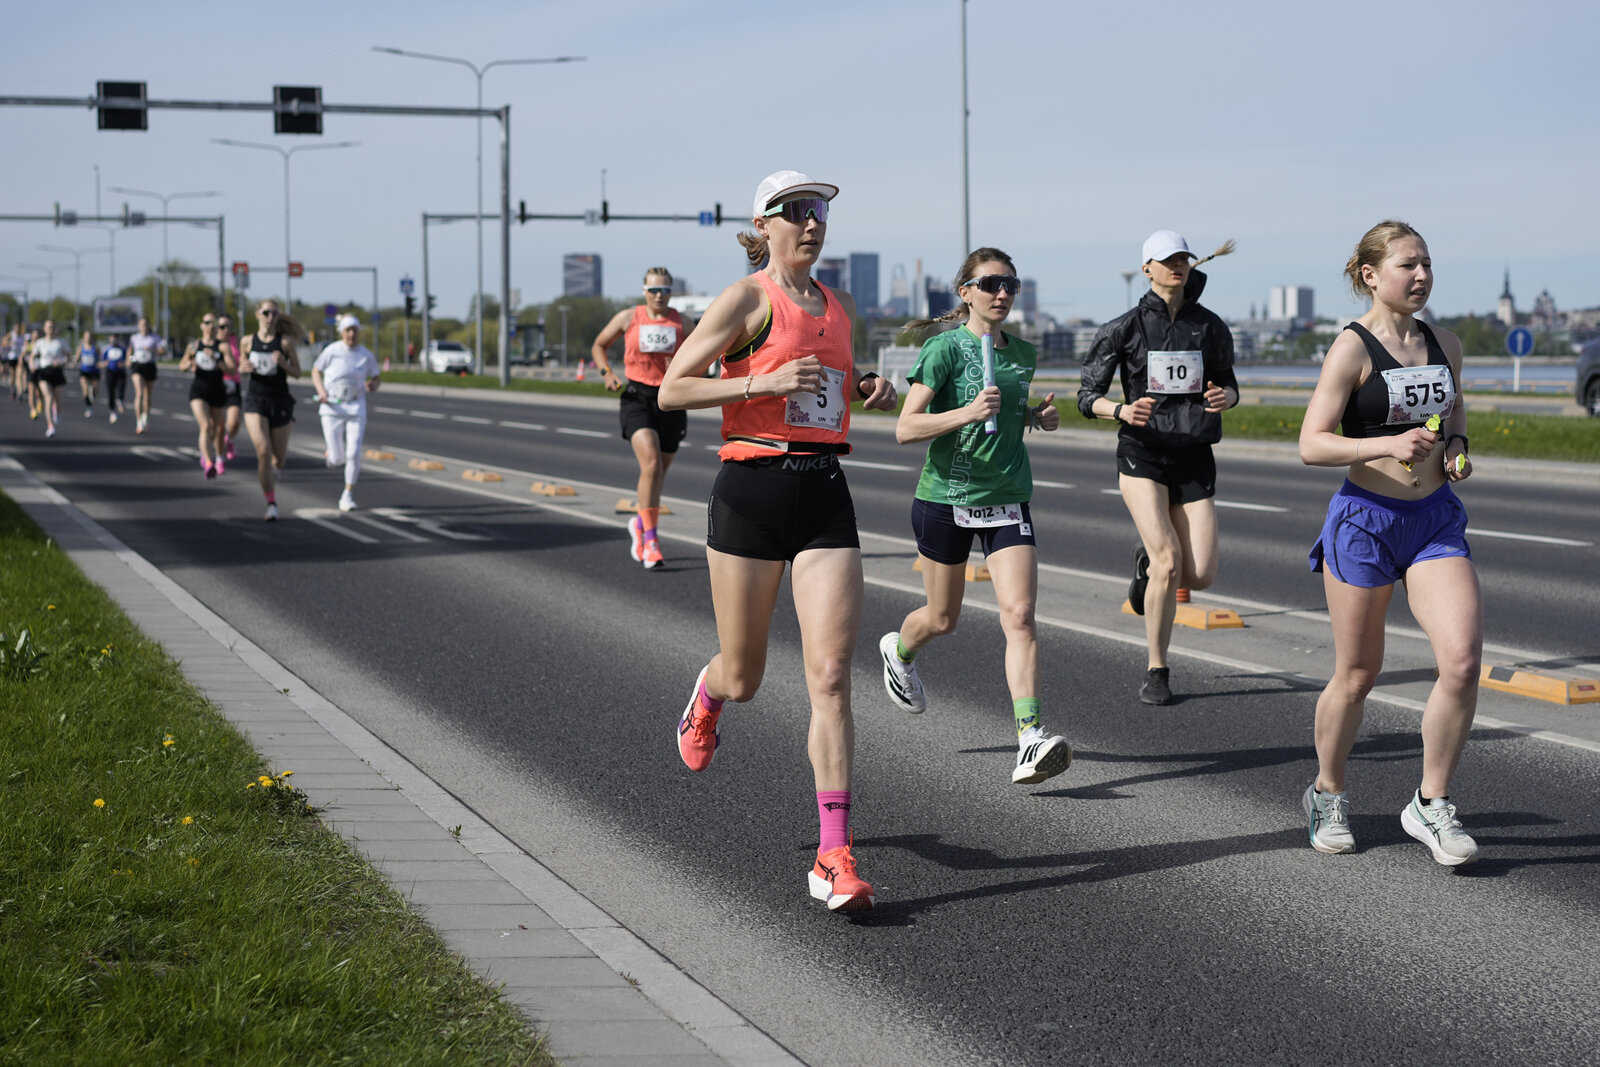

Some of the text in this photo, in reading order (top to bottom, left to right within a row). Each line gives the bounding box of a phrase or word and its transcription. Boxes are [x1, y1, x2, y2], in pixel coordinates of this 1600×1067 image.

[647, 334, 668, 344] 536
[1166, 364, 1187, 380] 10
[817, 387, 827, 408] 5
[1405, 382, 1446, 407] 575
[782, 456, 828, 471] NIKE
